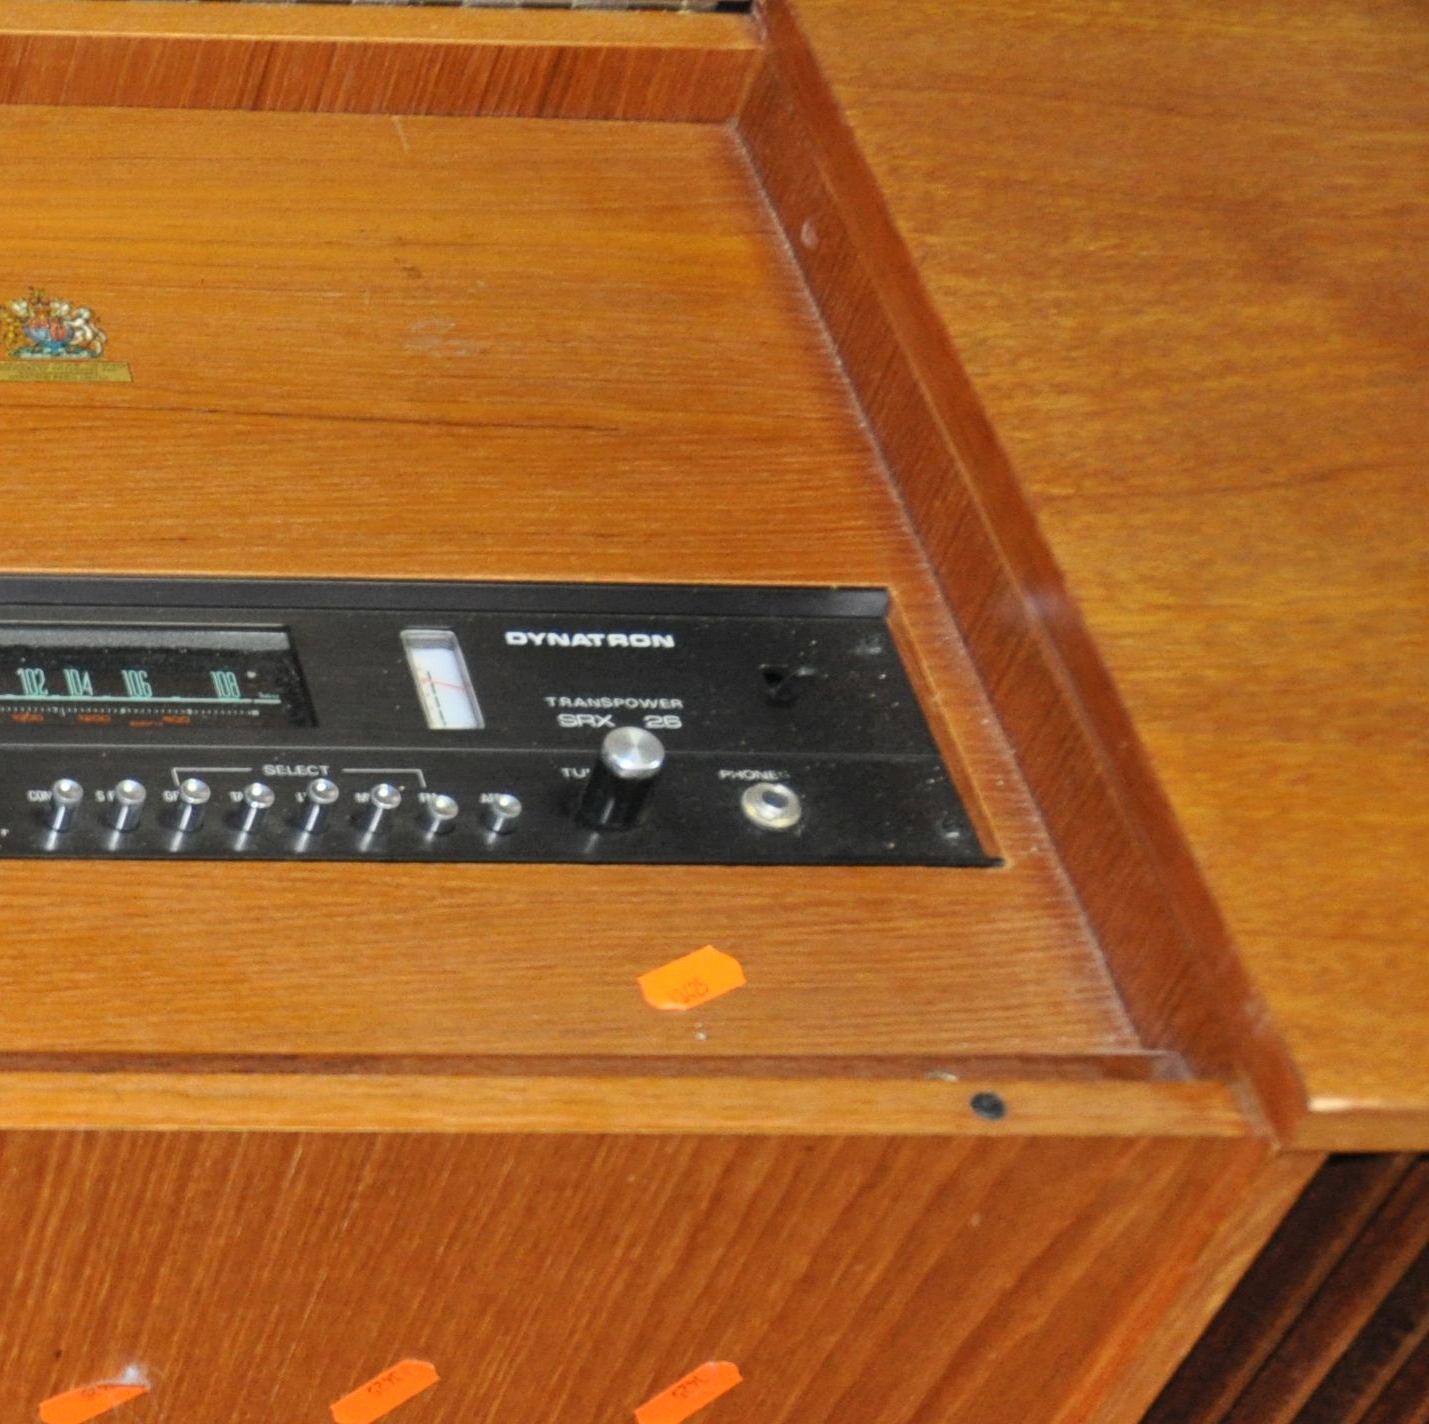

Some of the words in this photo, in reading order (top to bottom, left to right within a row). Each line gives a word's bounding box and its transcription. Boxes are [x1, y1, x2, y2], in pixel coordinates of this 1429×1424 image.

[504, 631, 676, 648] DYNATRON
[19, 668, 48, 695] 102
[63, 668, 94, 696] 104
[121, 669, 153, 698] 106
[209, 671, 241, 699] 108
[545, 696, 684, 710] TRANSPOWER
[556, 713, 616, 728] SRX
[643, 714, 683, 729] 26
[262, 764, 331, 777] SELECT
